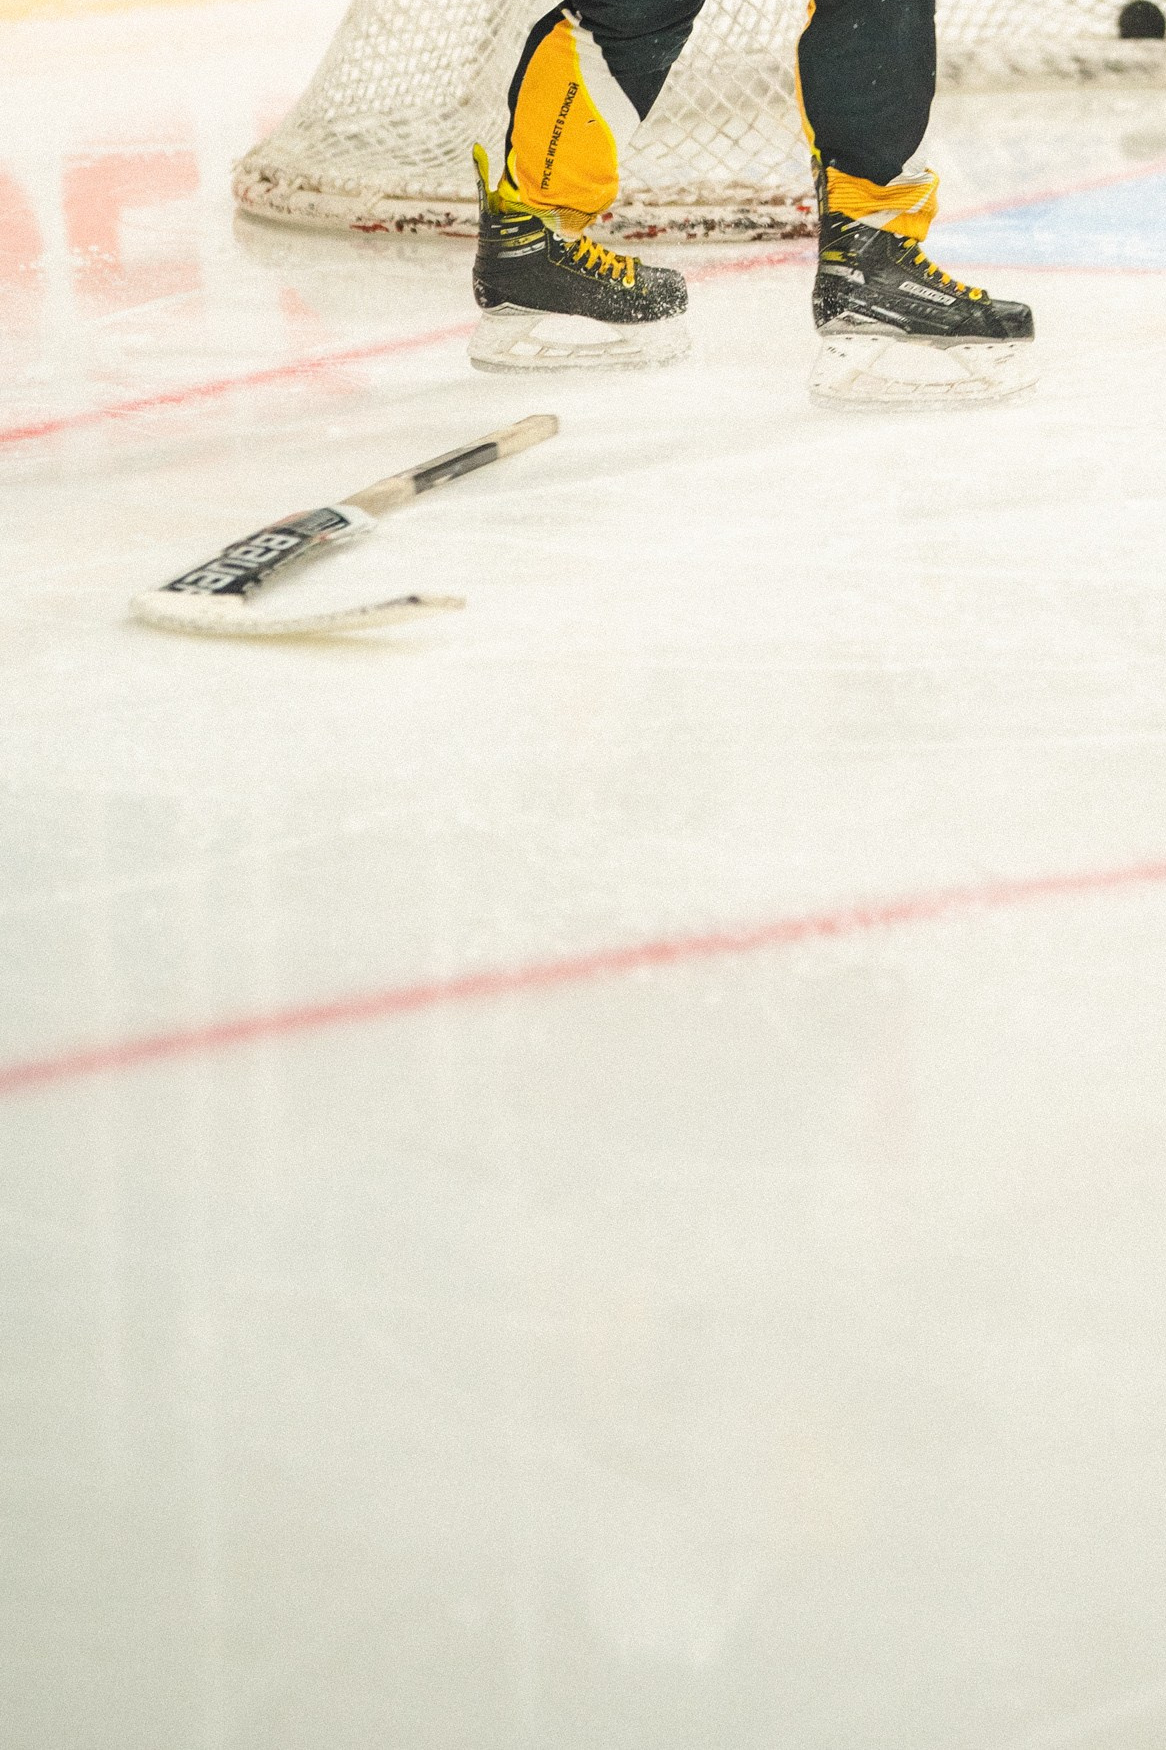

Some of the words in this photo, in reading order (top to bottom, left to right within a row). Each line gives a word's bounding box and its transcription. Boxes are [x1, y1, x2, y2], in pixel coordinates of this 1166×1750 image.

[559, 81, 579, 118] ХОККЕЙ
[547, 125, 563, 157] ИГРАЕТ
[545, 157, 554, 170] НЕ
[541, 170, 552, 190] ТРУС
